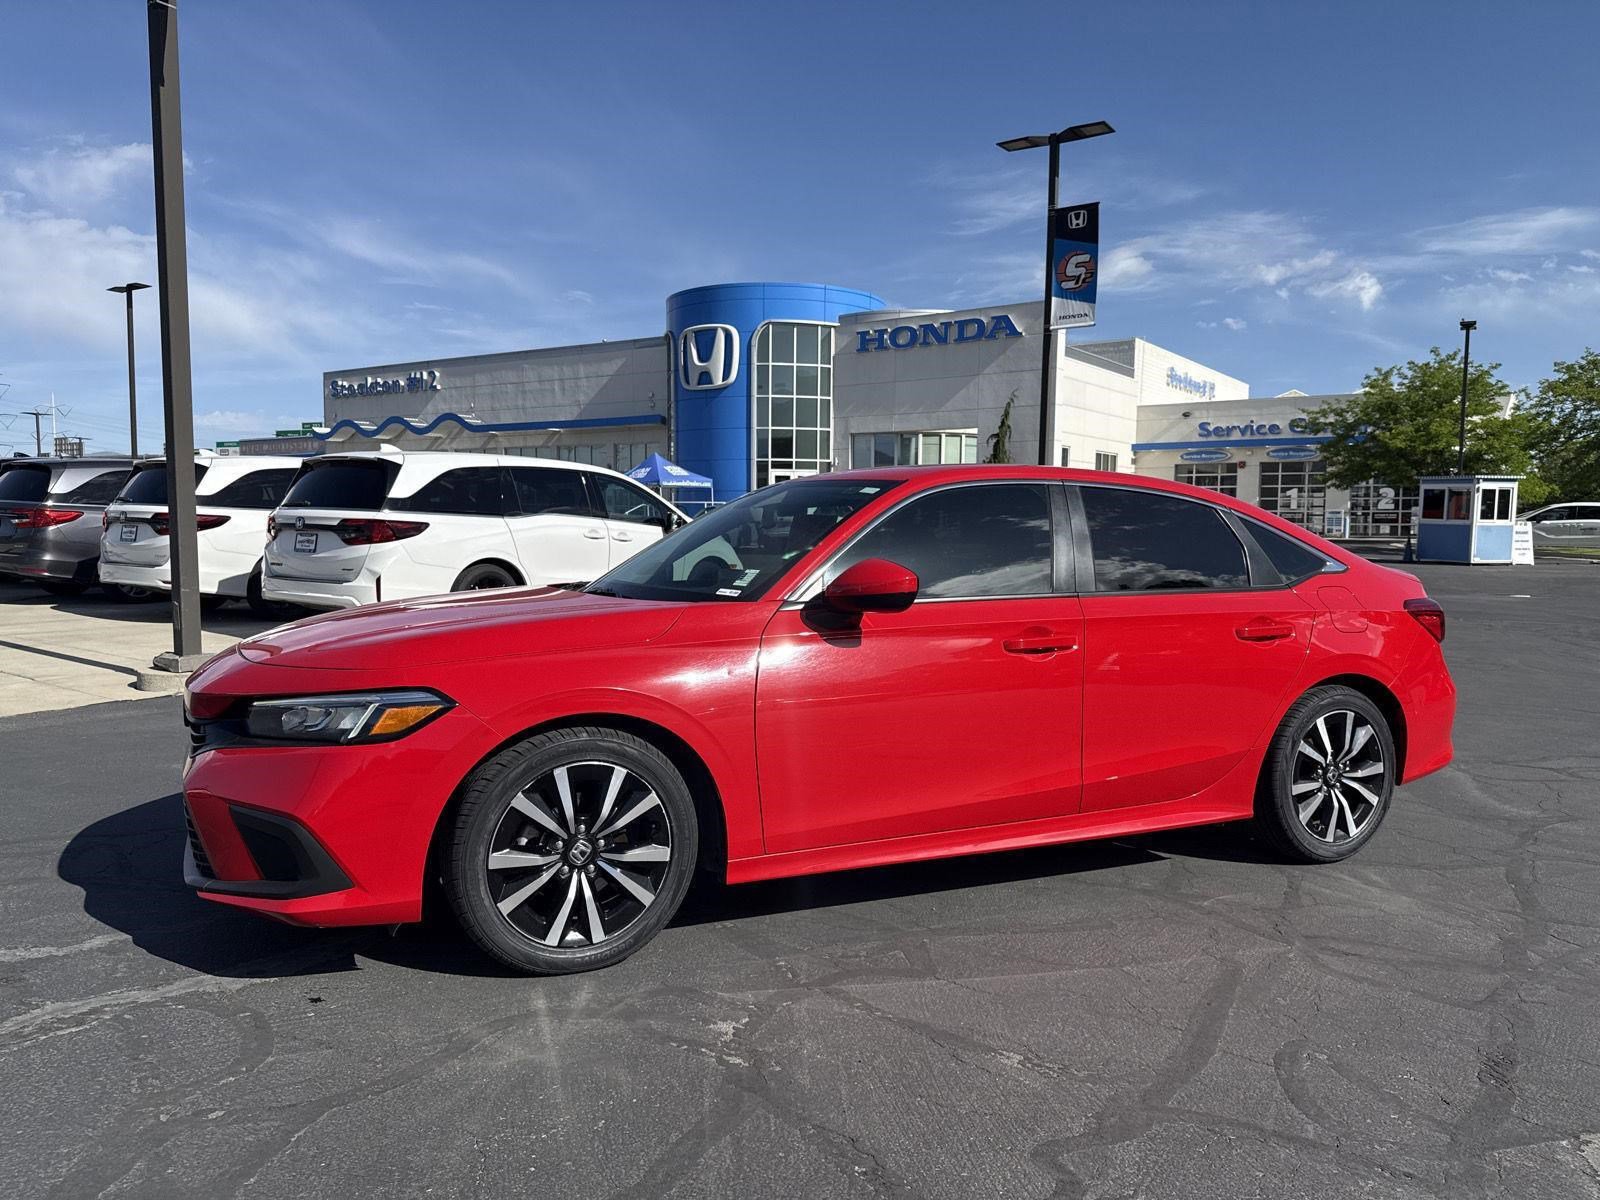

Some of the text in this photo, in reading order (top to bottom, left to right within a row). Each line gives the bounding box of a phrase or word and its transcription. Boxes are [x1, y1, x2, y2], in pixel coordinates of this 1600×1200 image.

[1059, 313, 1089, 321] HONDA
[856, 314, 1024, 353] HONDA
[406, 370, 440, 392] #12
[1198, 420, 1281, 438] Service
[1286, 488, 1298, 510] 1
[1377, 487, 1395, 510] 2
